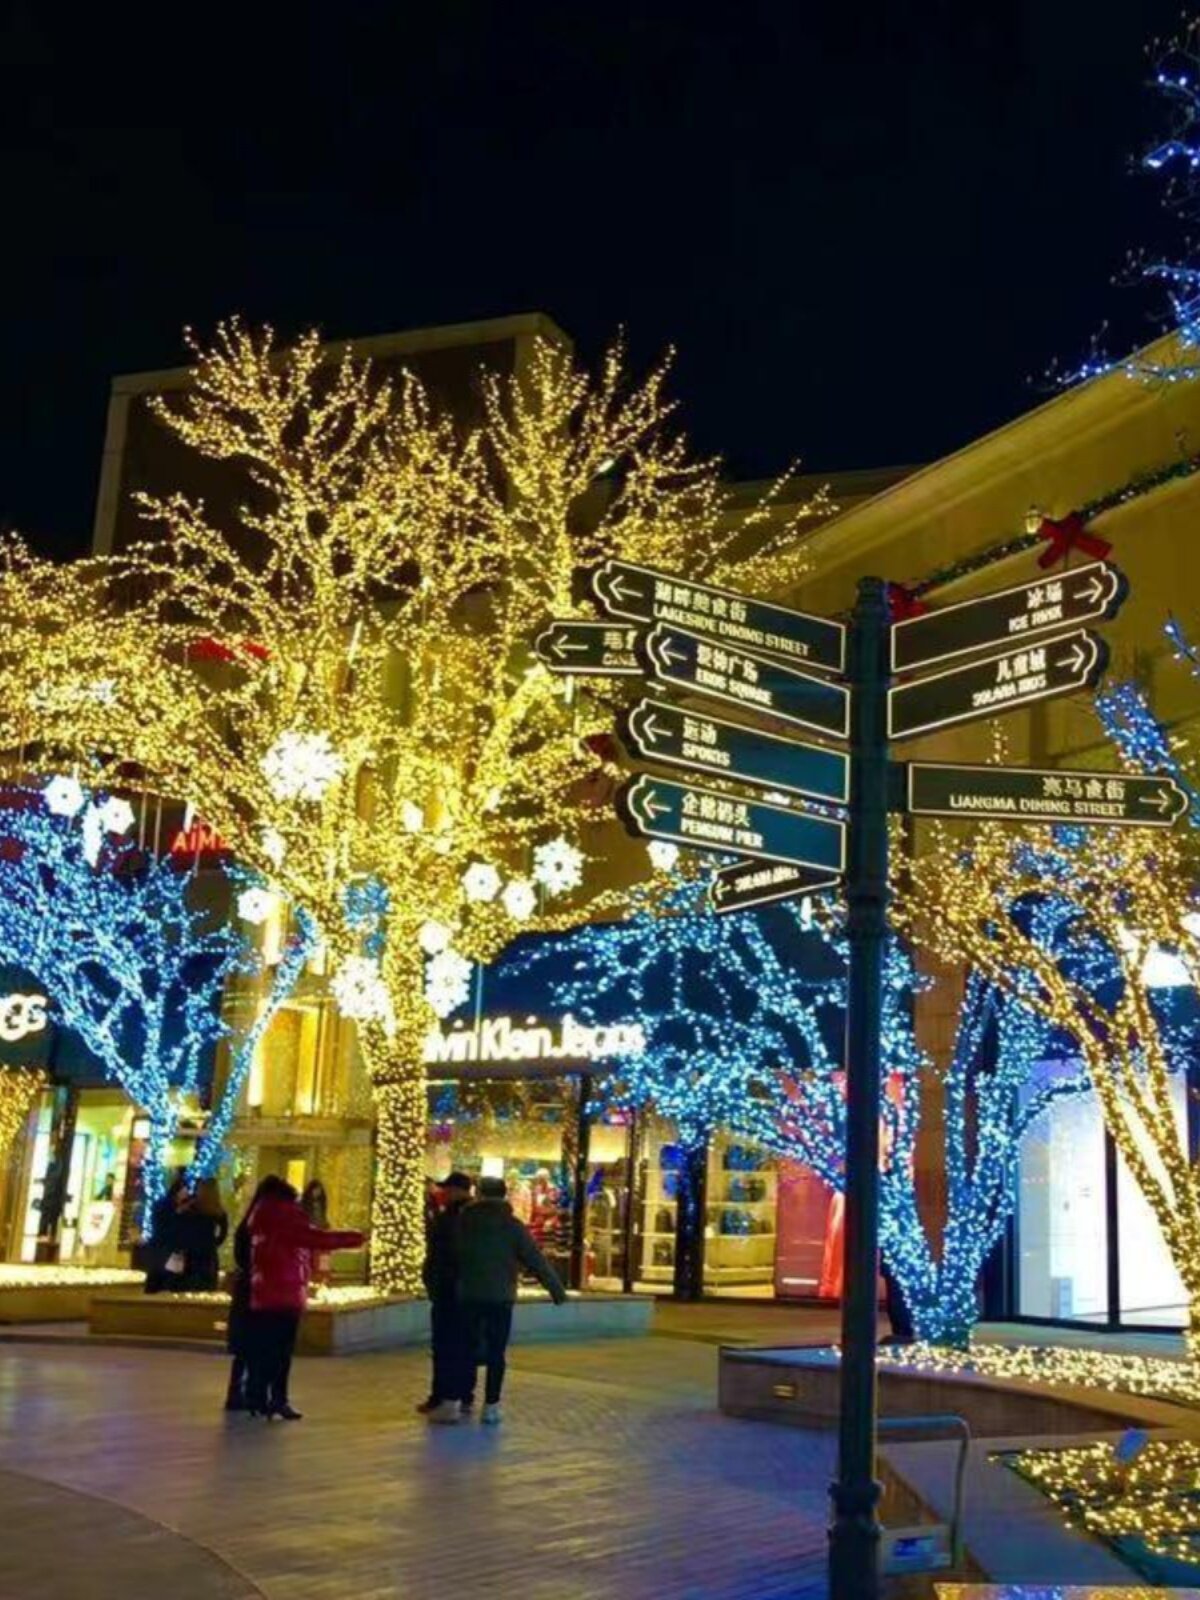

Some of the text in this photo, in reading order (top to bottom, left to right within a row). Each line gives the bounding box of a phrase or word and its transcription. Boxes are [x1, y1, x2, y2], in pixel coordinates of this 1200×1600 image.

[653, 603, 809, 656] LAKESIDE DINING STREET
[1009, 618, 1029, 633] ICE
[682, 742, 731, 767] SPORTS
[949, 794, 1126, 817] LIANGMA DINING STREET
[0, 994, 48, 1041] GG
[481, 1016, 552, 1060] Klein
